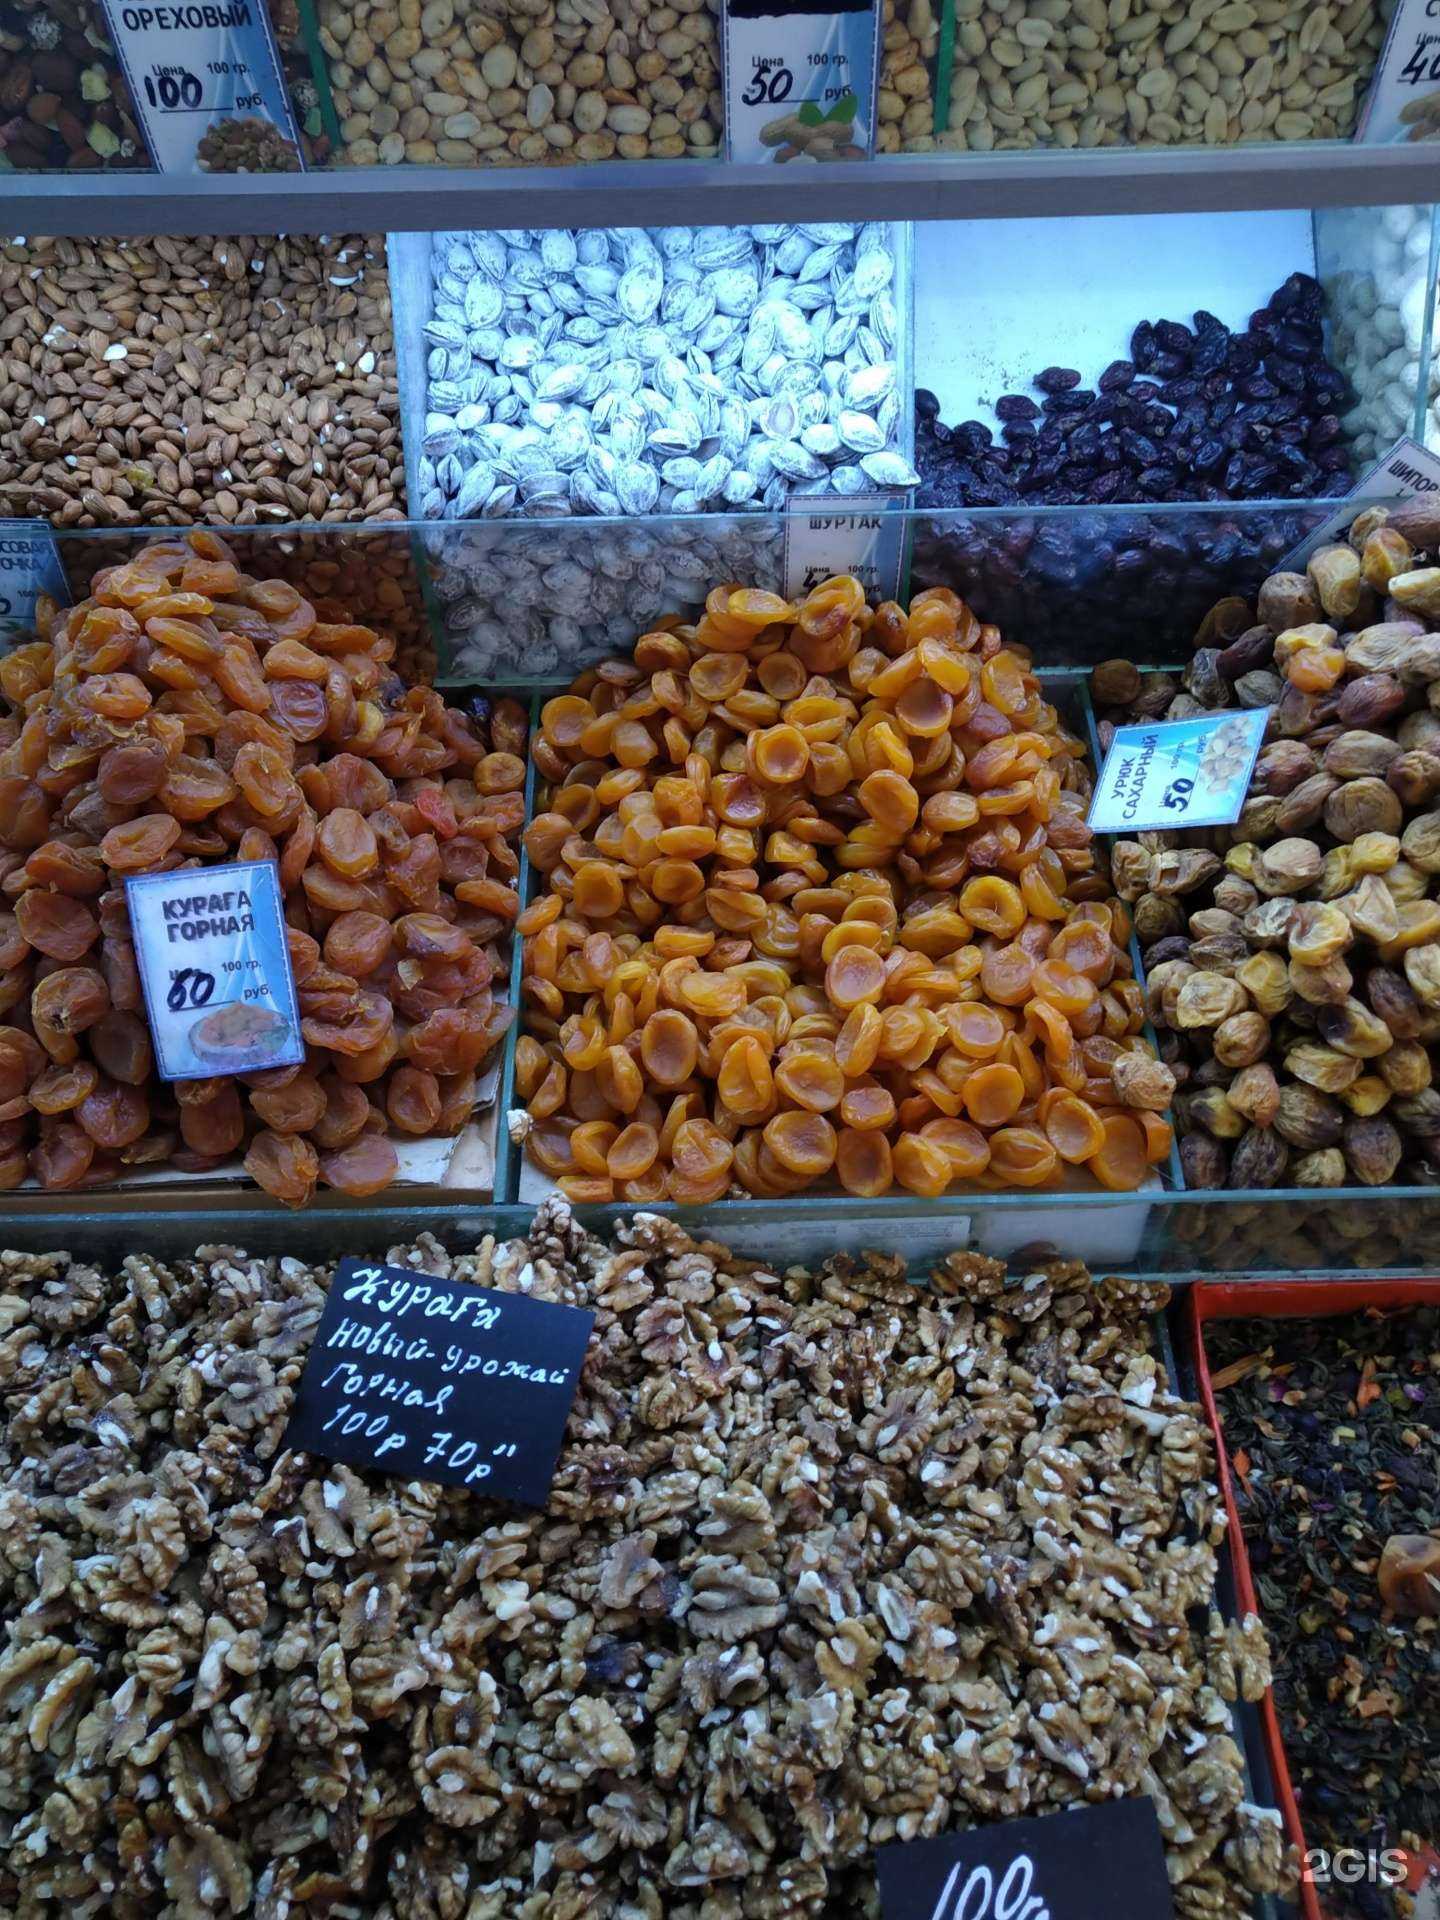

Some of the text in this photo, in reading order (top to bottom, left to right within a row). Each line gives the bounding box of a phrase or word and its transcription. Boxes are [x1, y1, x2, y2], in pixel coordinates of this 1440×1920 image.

[122, 0, 253, 31] ОРЕХОВЫЙ
[152, 61, 251, 77] Цена 100 гр.
[752, 54, 849, 67] Цена 100 гр.
[143, 72, 204, 109] 100
[235, 92, 267, 112] руб.
[741, 67, 794, 107] 50
[809, 515, 882, 530] ШУРТАК
[805, 565, 831, 574] Цена
[847, 565, 864, 574] 100
[1111, 757, 1136, 800] УРЮК
[1122, 733, 1160, 820] САХАРНЫЙ
[1164, 777, 1195, 813] 50
[162, 890, 252, 921] КУРАГА
[166, 913, 256, 943] ГОРНАЯ
[221, 958, 262, 974] 100 гр.
[166, 967, 216, 1010] 60
[244, 983, 273, 1001] руб.
[343, 1267, 502, 1330] Курага
[321, 1362, 454, 1415] Горная
